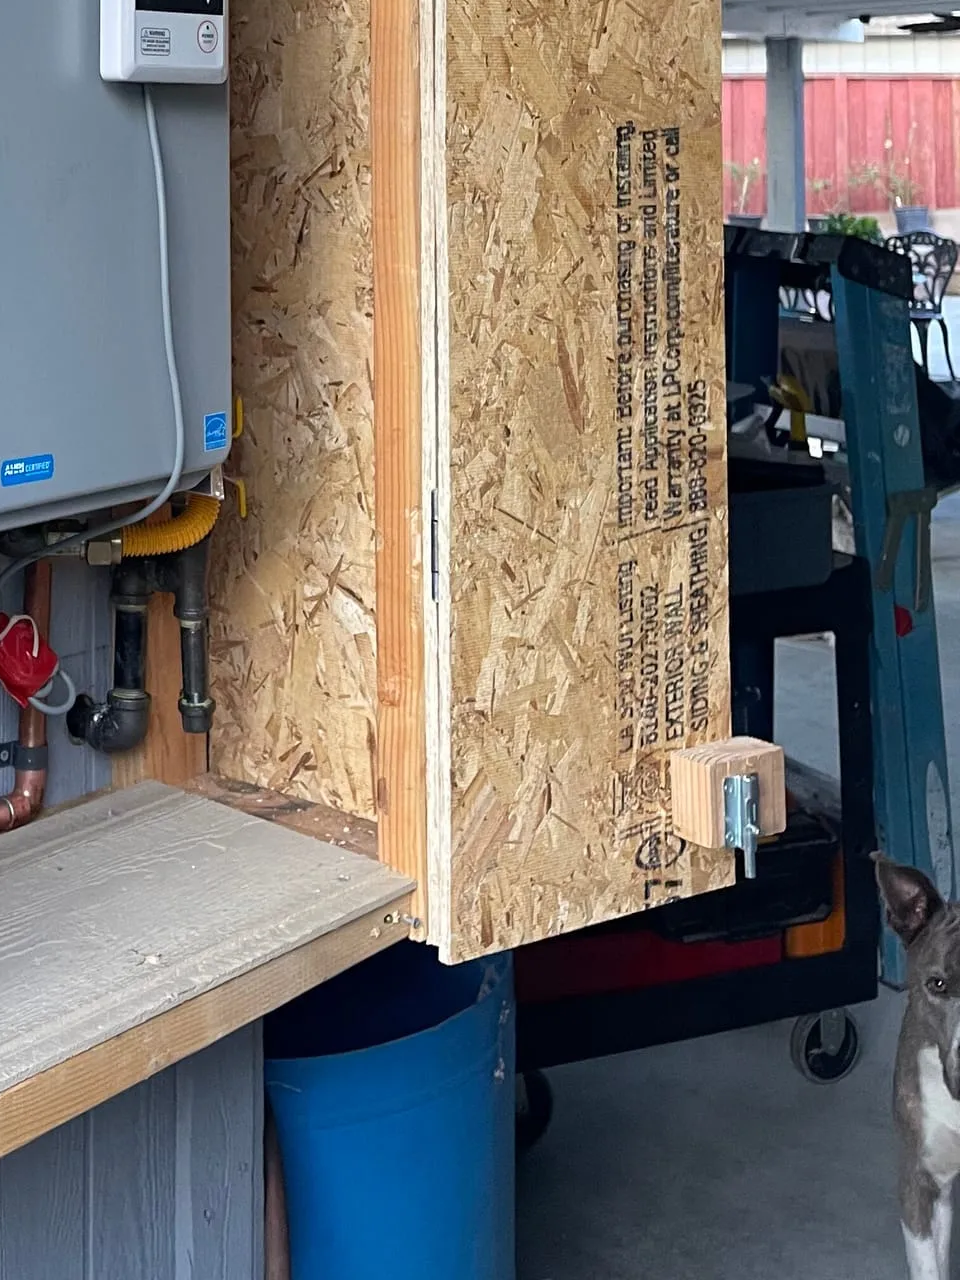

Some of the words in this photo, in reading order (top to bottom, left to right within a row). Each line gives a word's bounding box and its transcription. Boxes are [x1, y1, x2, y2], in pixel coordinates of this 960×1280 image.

[639, 129, 657, 199] Limited
[661, 127, 680, 157] call
[666, 163, 680, 183] or
[617, 212, 632, 234] or
[639, 204, 657, 239] and
[617, 240, 636, 348] purchasing
[617, 352, 632, 418] Before
[664, 401, 681, 422] at
[663, 428, 686, 522] Warranty
[687, 379, 708, 514] 888-820-6325
[640, 477, 658, 521] read
[664, 581, 683, 642] WALL
[688, 524, 708, 636] SHEATHING
[664, 644, 685, 742] EXTERIOR
[690, 657, 709, 732] SIDING
